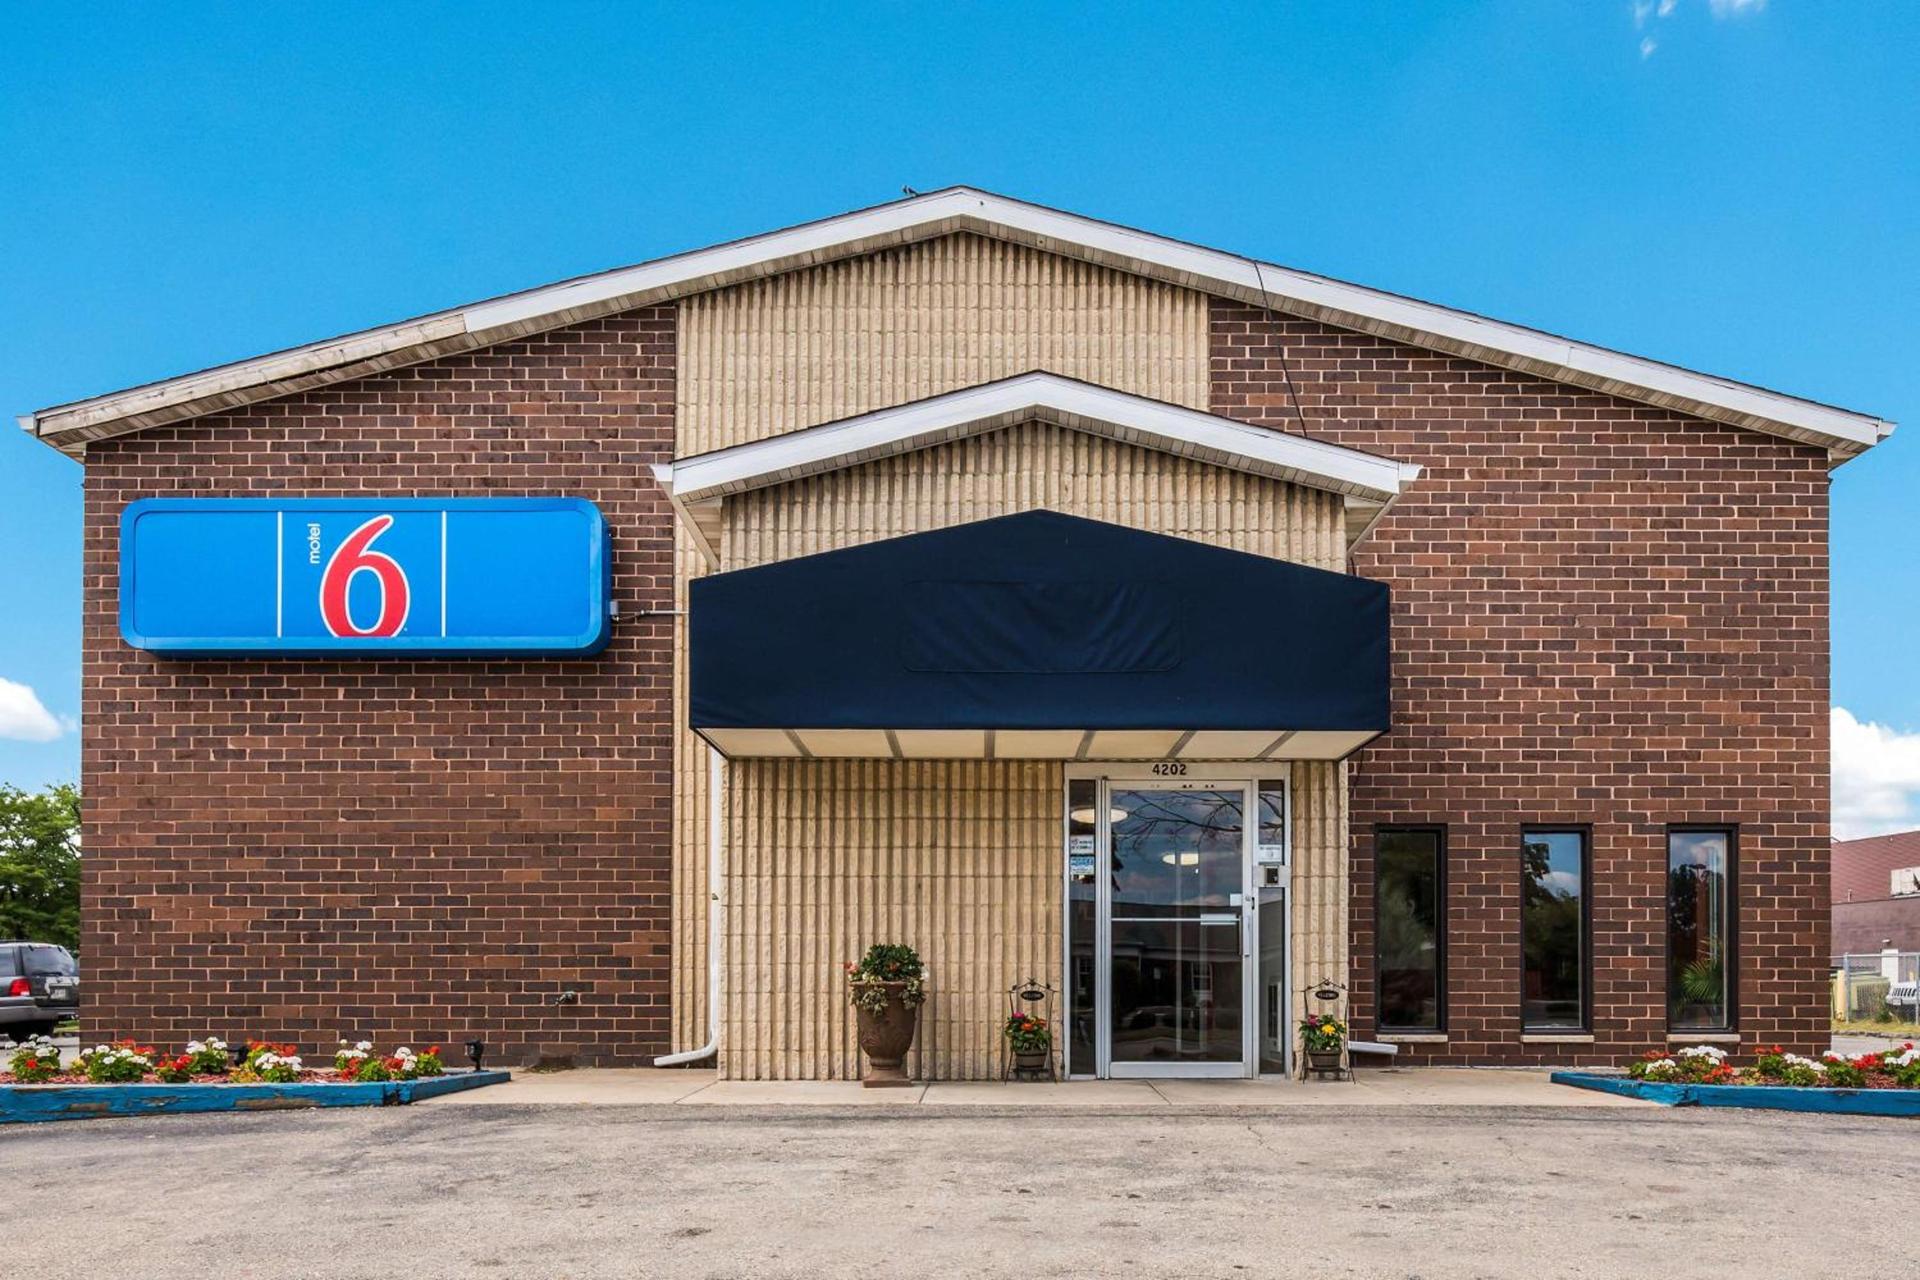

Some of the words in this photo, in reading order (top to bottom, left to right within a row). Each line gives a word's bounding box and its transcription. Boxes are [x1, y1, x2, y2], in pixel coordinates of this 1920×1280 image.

[307, 523, 321, 564] motel
[319, 514, 411, 638] 6
[1152, 763, 1187, 776] 4202
